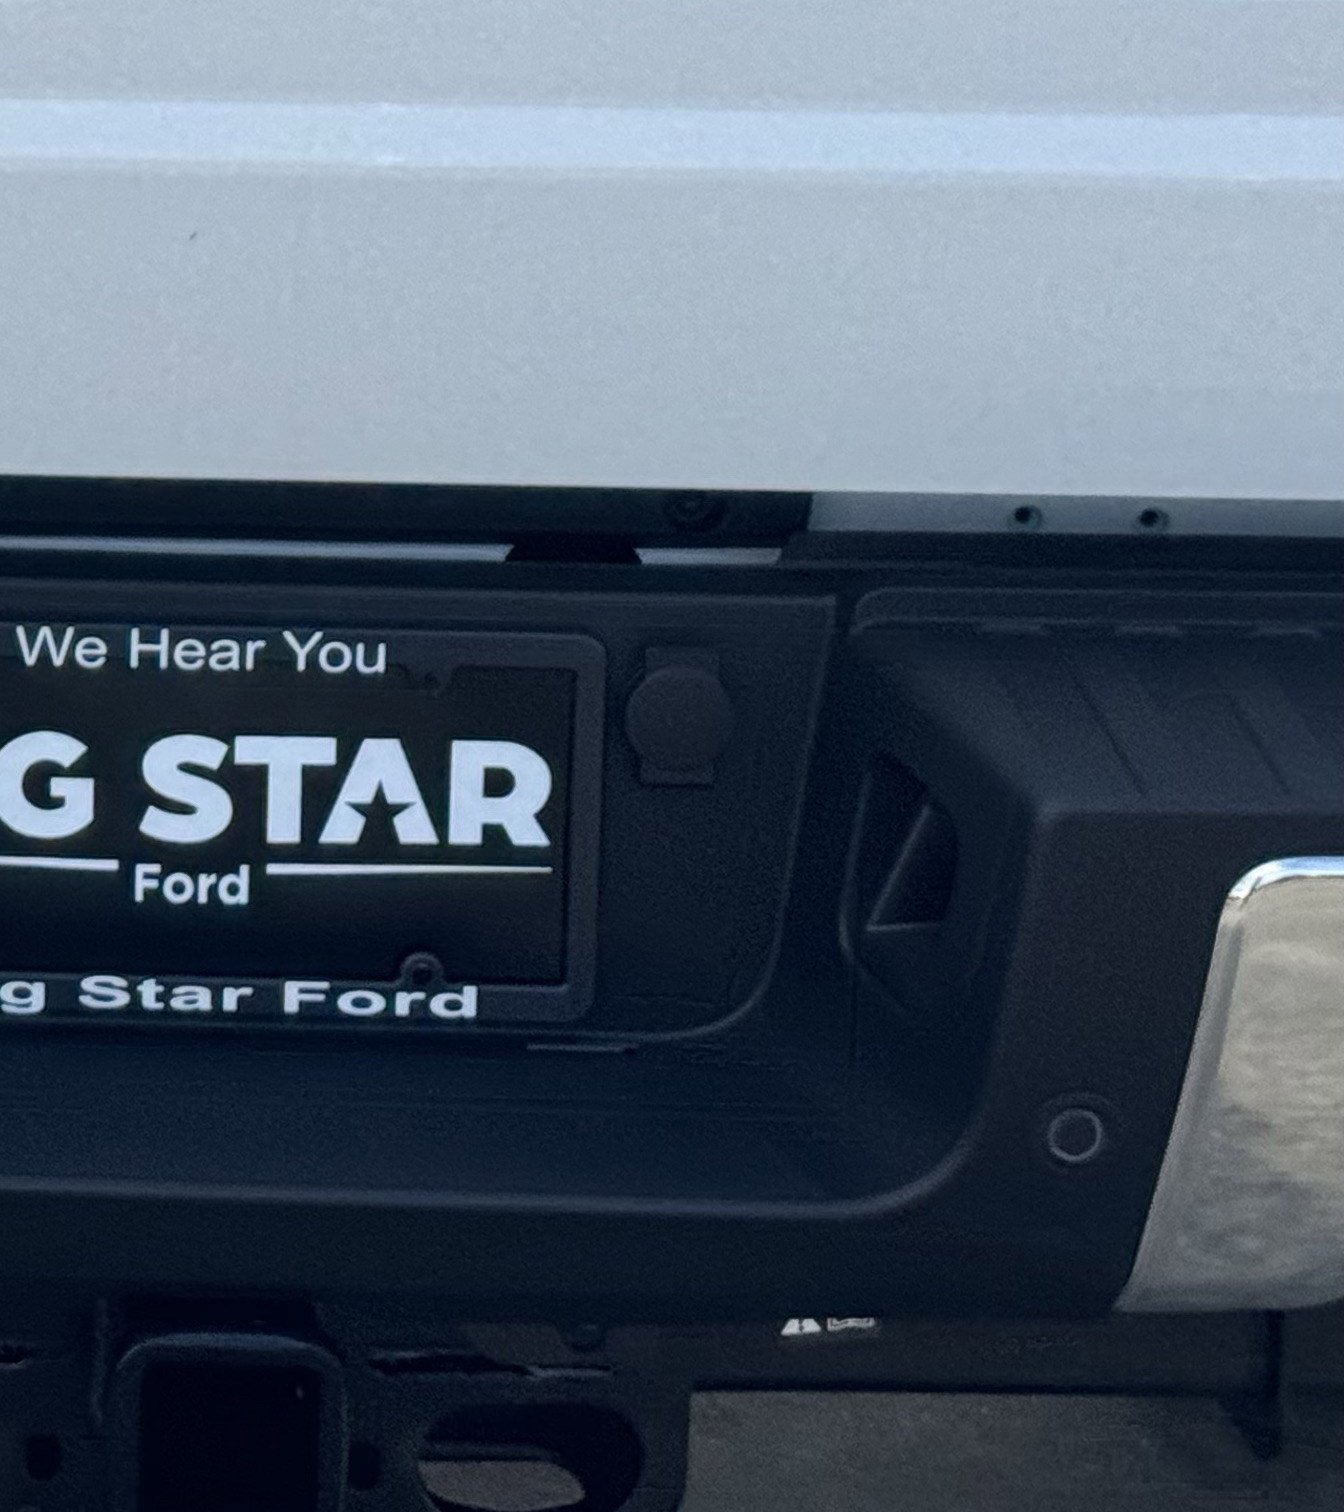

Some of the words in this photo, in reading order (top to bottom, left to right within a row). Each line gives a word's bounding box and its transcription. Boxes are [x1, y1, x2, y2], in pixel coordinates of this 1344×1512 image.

[14, 624, 109, 670] We
[128, 626, 268, 673] Hear
[281, 629, 388, 675] You
[137, 733, 553, 848] STAR
[133, 862, 251, 906] Ford
[77, 974, 255, 1013] Star
[282, 979, 479, 1020] Ford
